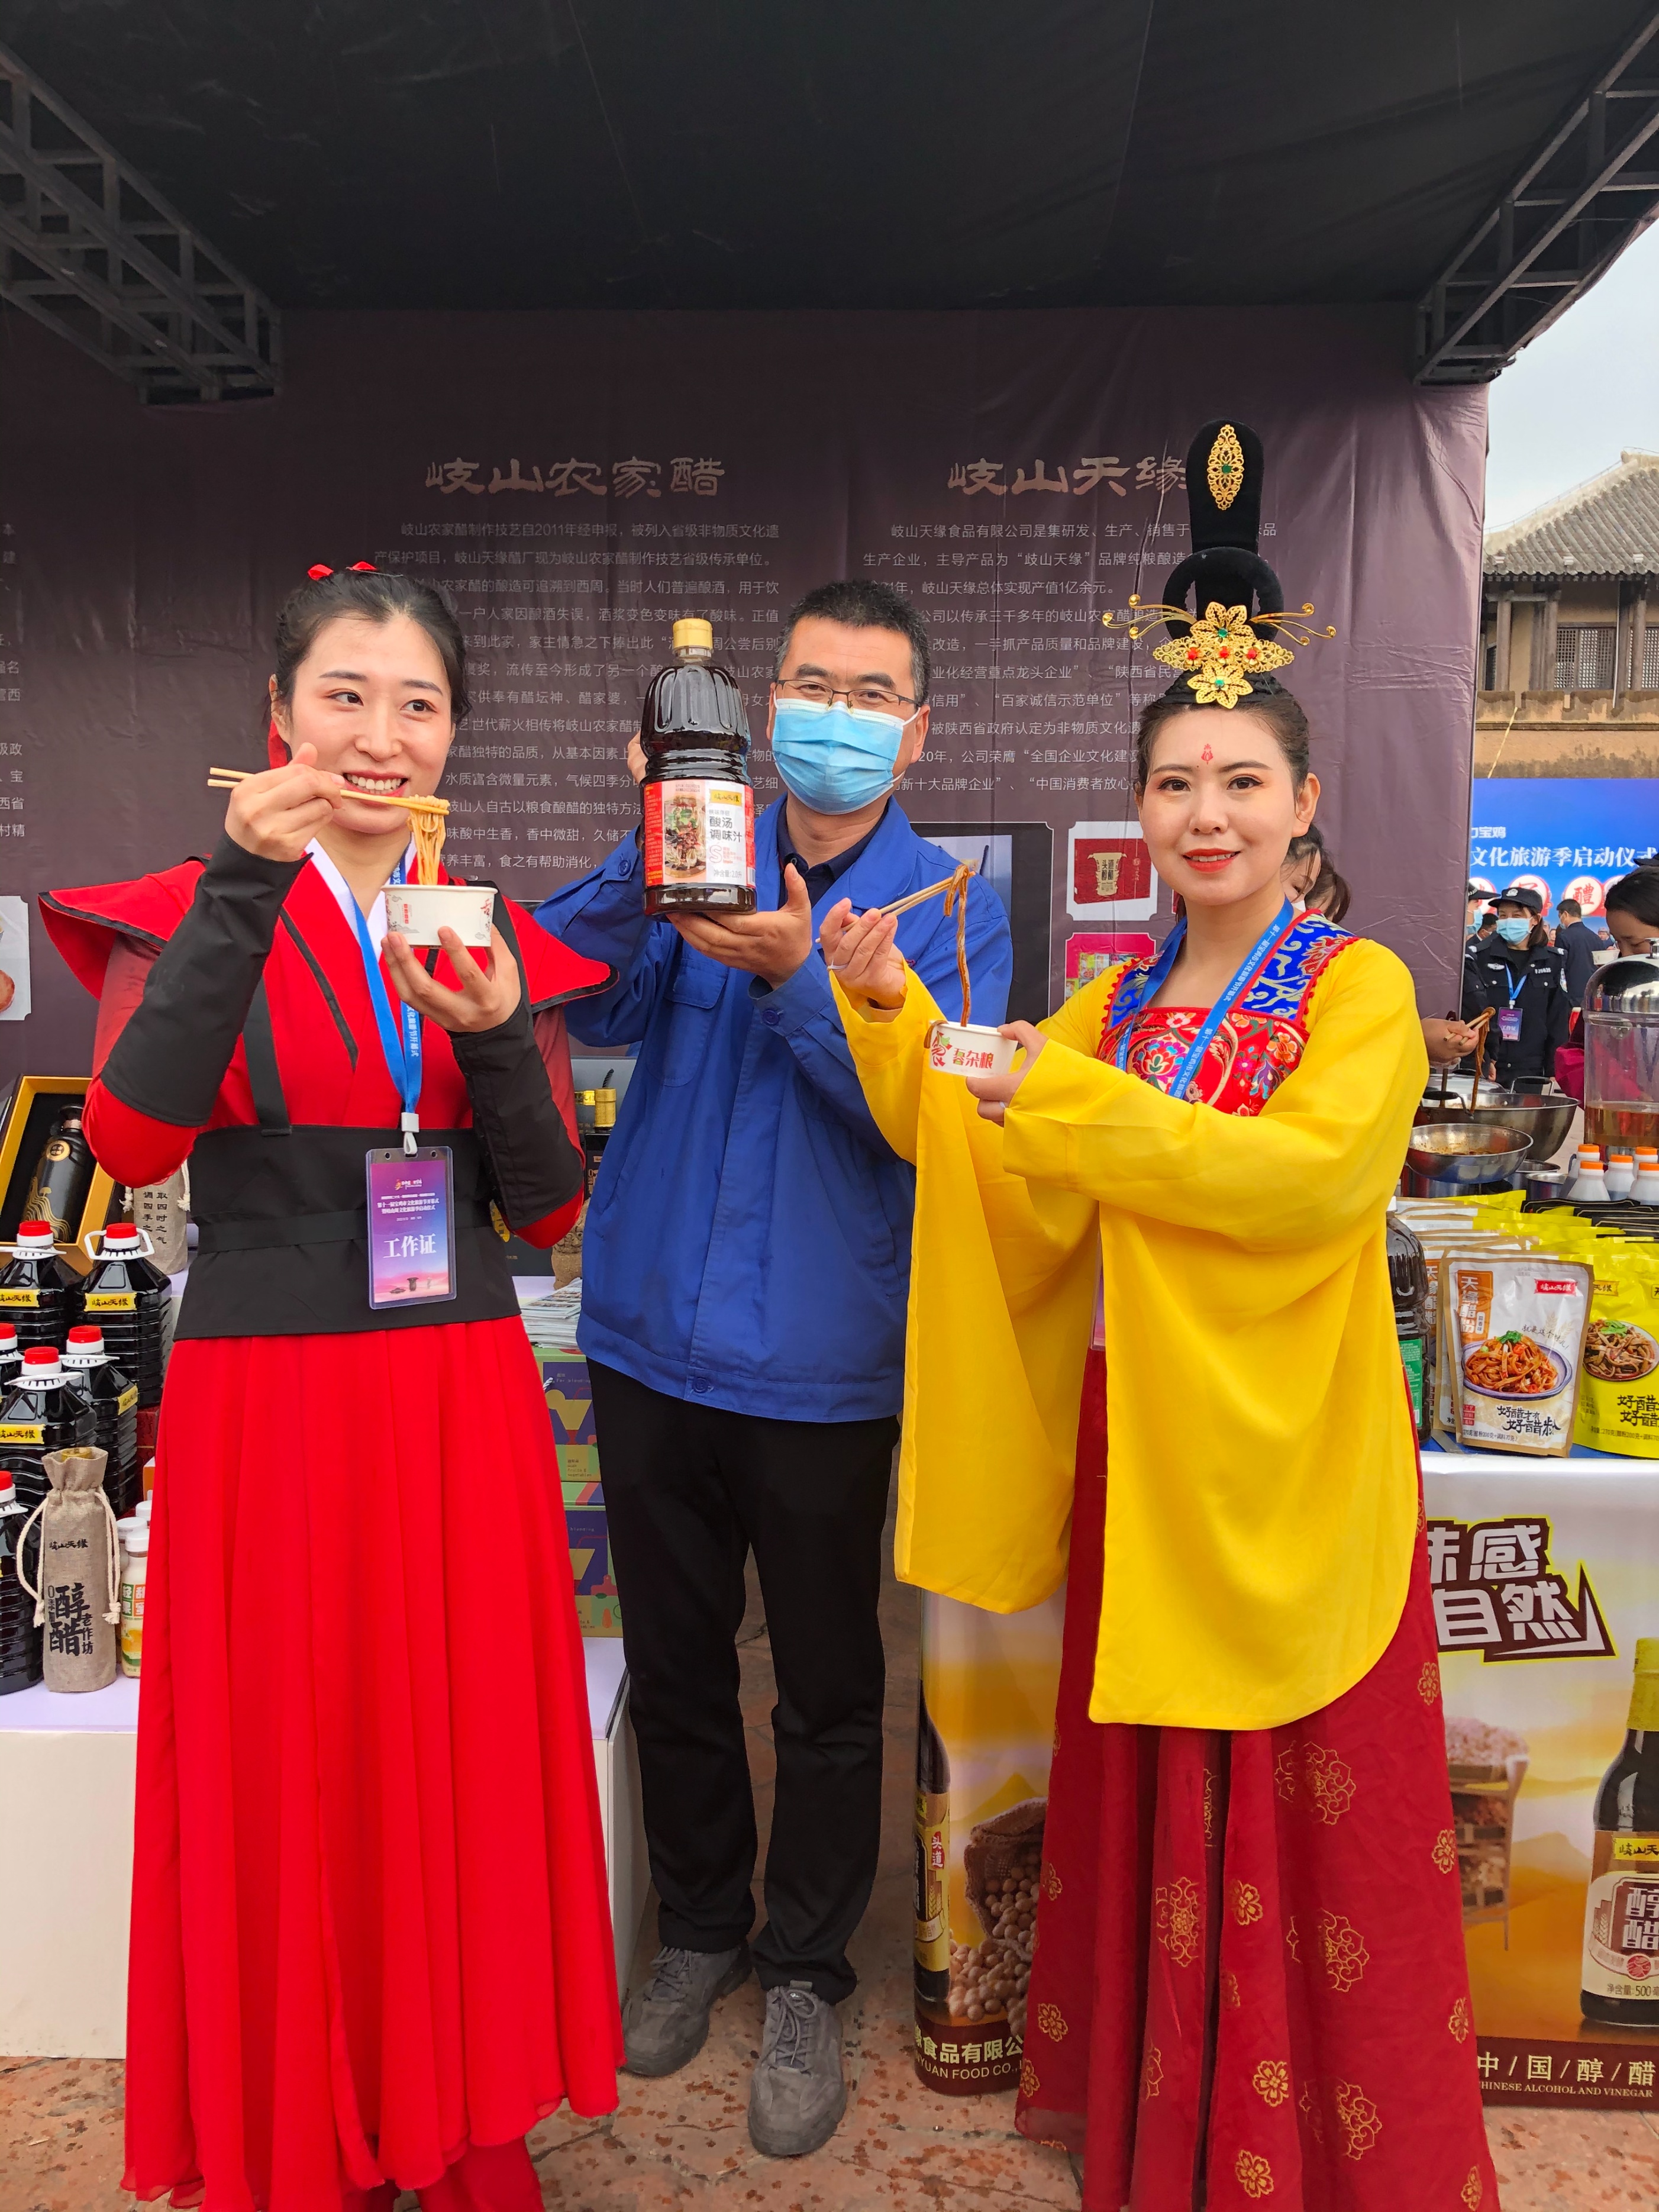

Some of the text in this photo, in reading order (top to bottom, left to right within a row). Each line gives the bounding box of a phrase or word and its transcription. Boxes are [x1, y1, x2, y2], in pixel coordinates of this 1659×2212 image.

[425, 456, 725, 498] 岐山农家醋
[947, 456, 1186, 496] 岐山天缘
[1258, 523, 1276, 536] 品
[709, 816, 733, 828] 酸汤
[709, 830, 743, 843] 调味汁
[383, 1233, 437, 1259] 工作证
[1617, 1394, 1659, 1412] 好醋
[1432, 1581, 1582, 1646] 自然
[931, 1836, 944, 1868] 头道
[953, 2068, 989, 2079] FOOD
[1479, 2081, 1653, 2098] HINESE ALCOHOL AND VINEGAR
